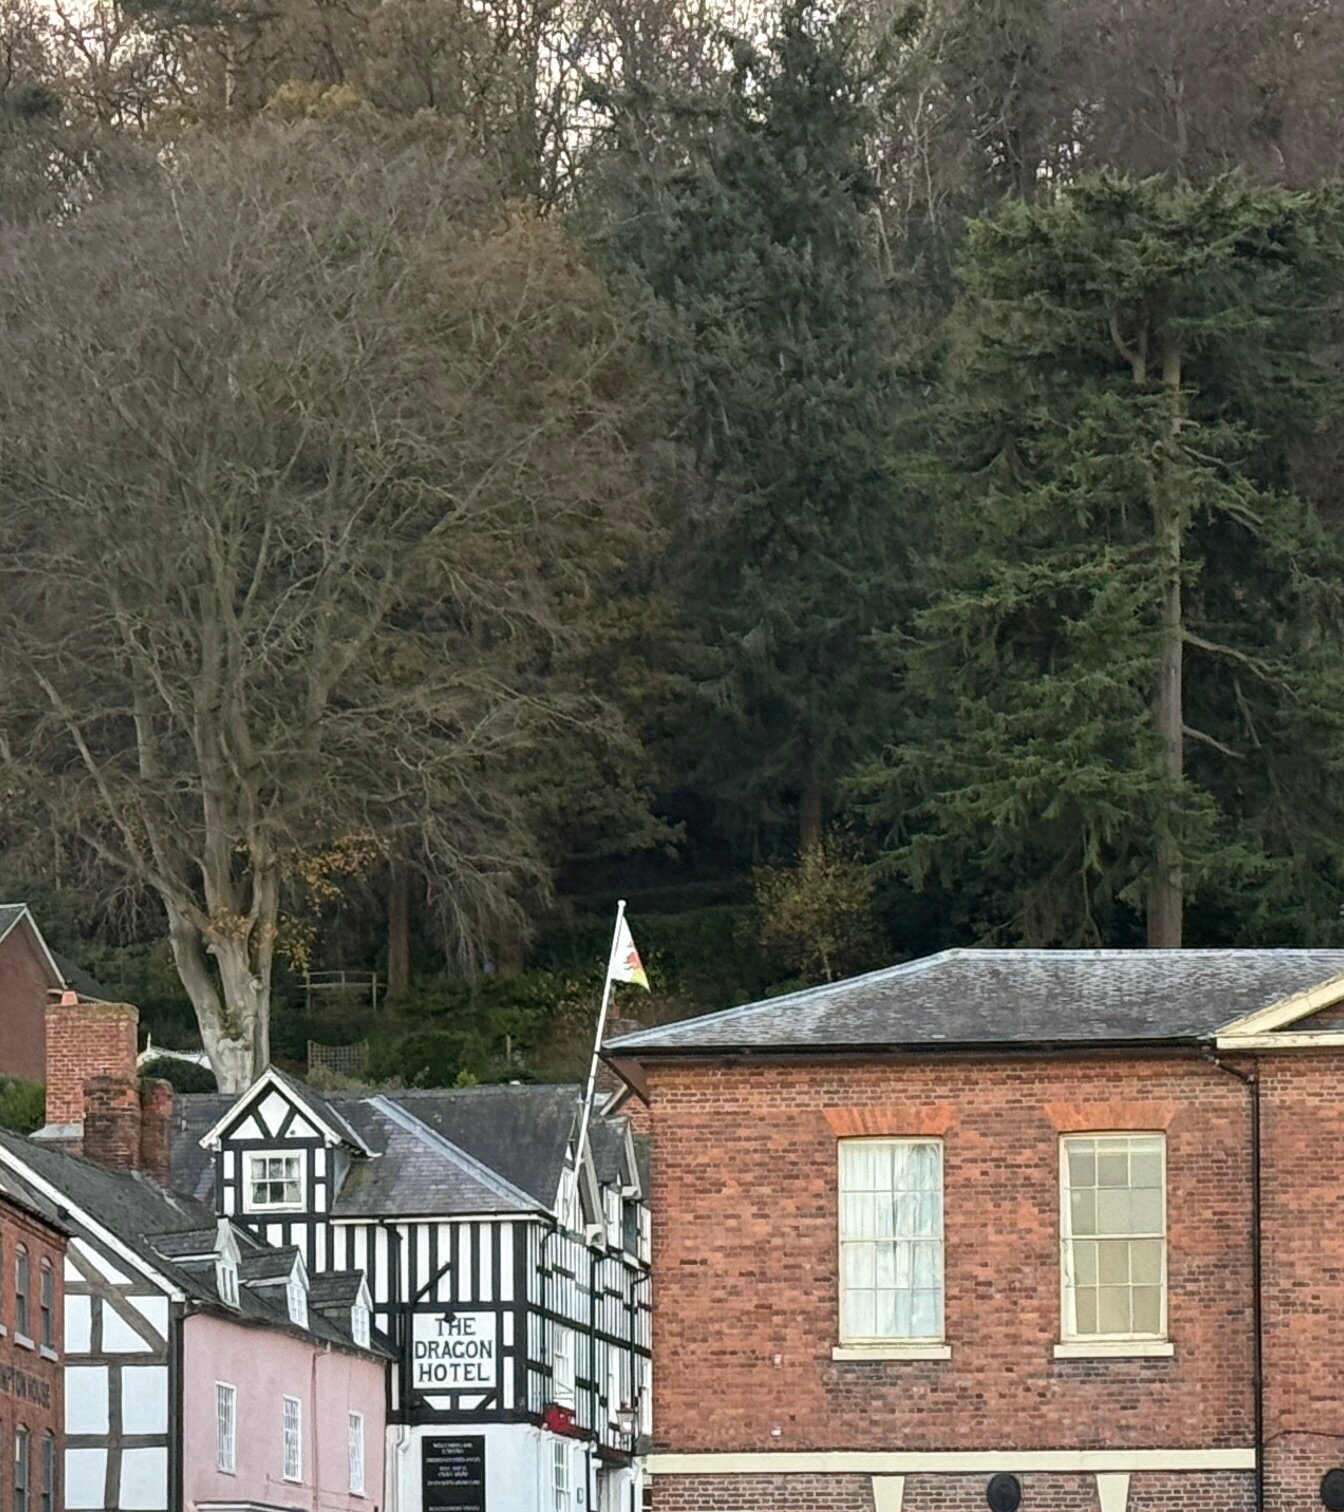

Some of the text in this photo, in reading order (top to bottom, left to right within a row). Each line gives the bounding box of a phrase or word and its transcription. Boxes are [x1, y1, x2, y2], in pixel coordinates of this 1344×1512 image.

[435, 1317, 476, 1336] THE
[415, 1340, 493, 1359] DRAGON
[418, 1363, 490, 1382] HOTEL
